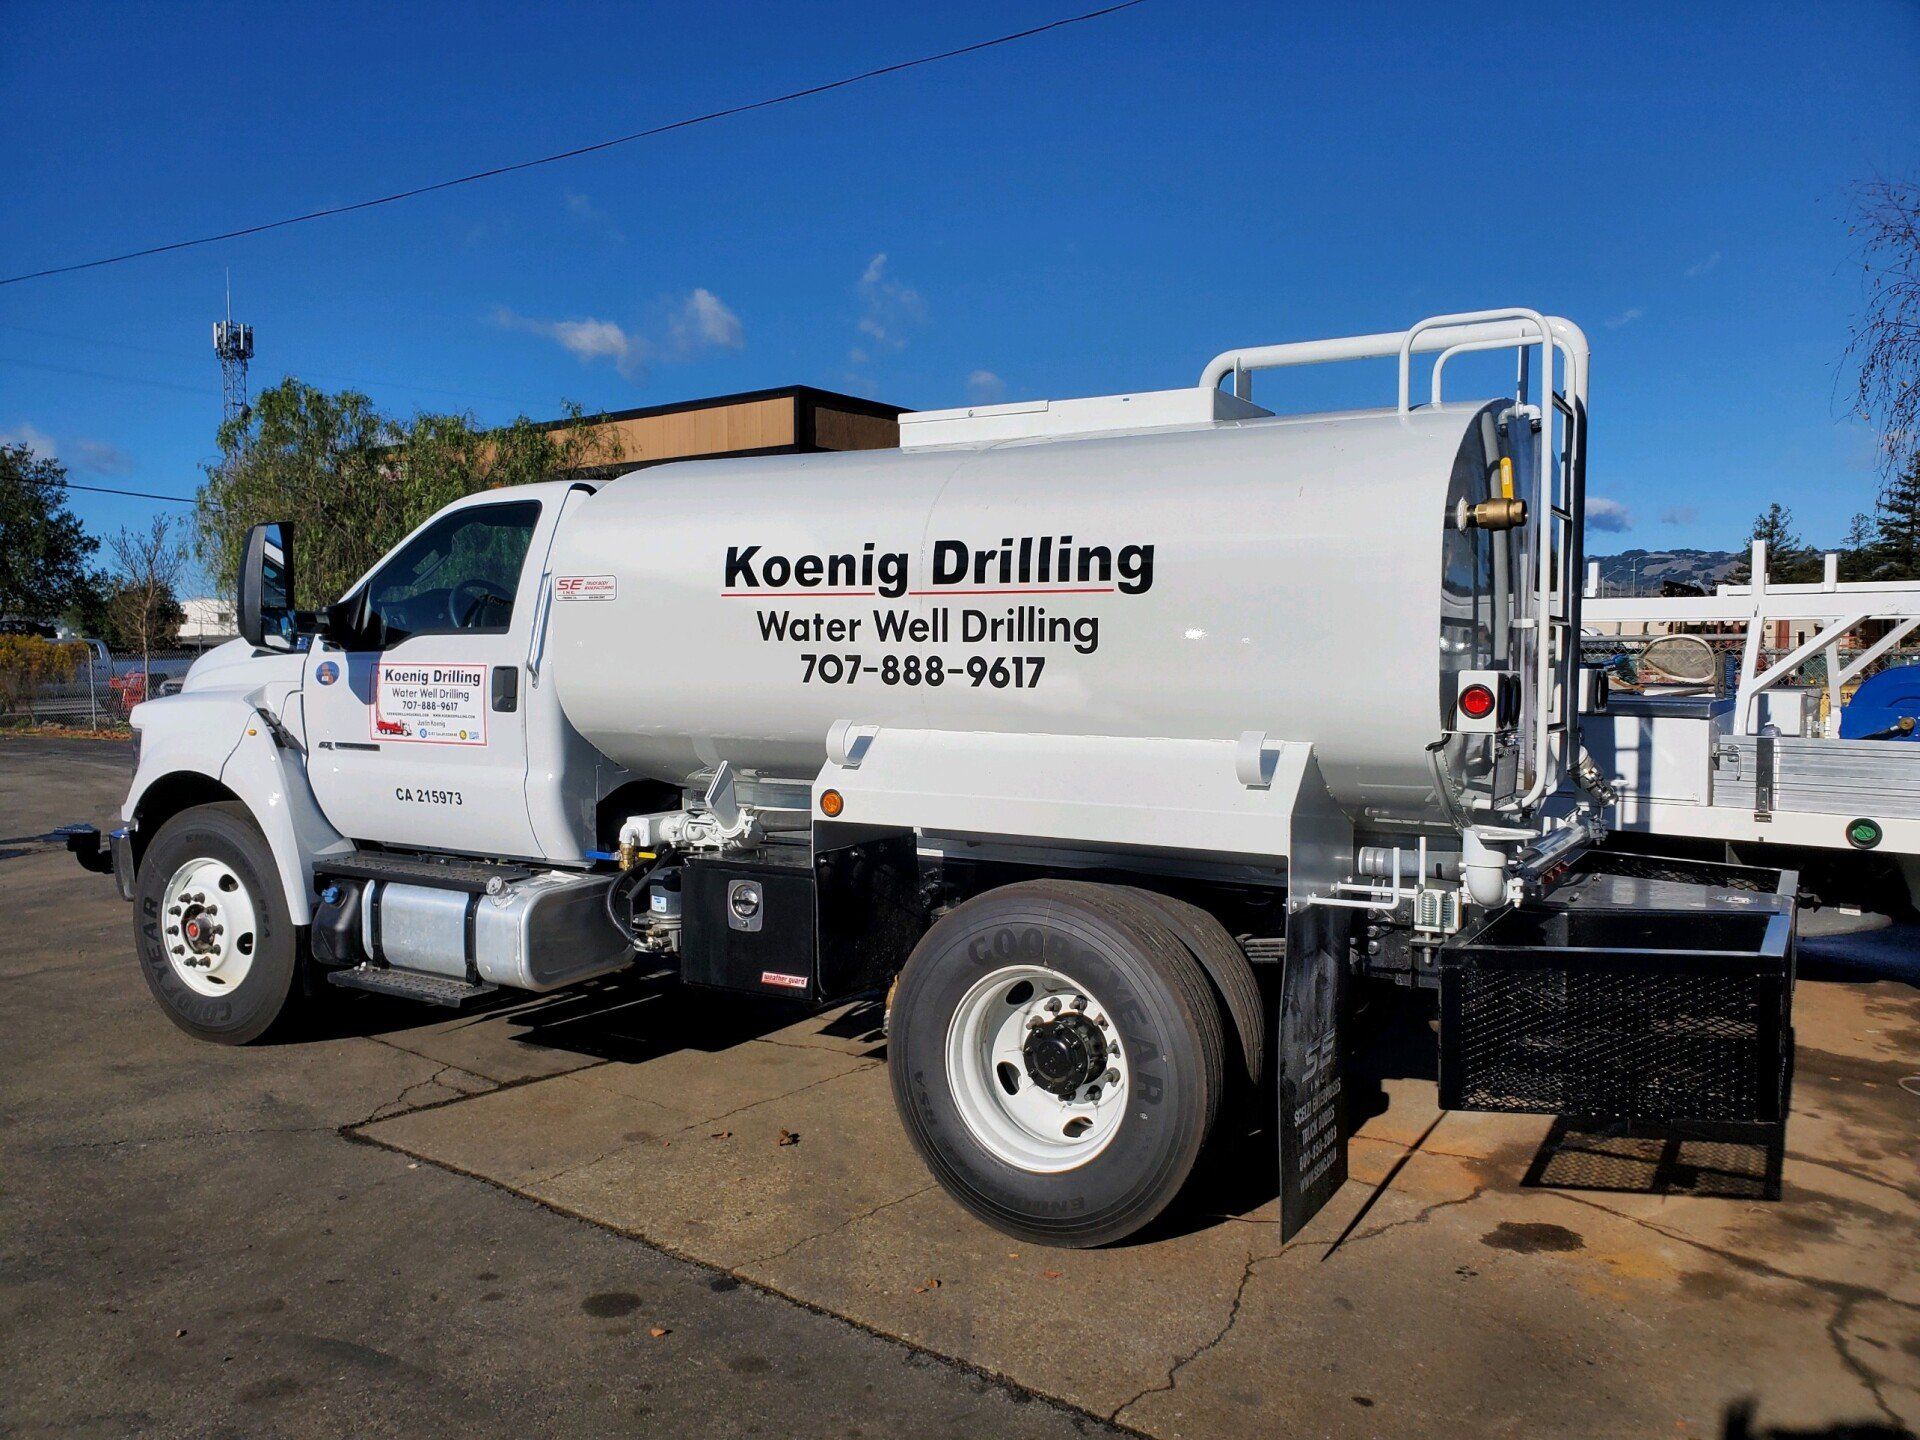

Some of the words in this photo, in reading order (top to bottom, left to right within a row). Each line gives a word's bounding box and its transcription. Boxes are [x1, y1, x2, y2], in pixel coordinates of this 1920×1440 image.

[724, 543, 909, 598] Koenig
[932, 535, 1155, 595] Drilling
[557, 579, 584, 590] SE
[756, 610, 861, 643] Water
[873, 606, 948, 643] Well
[962, 606, 1099, 654] Drilling
[385, 669, 429, 686] Koenig
[433, 670, 481, 687] Drilling
[800, 654, 1046, 688] 707-888-9617
[392, 688, 417, 698] Water
[419, 688, 438, 699] Well
[439, 689, 470, 702] Drilling
[402, 701, 459, 711] 707-888-9617
[395, 787, 414, 802] CA
[416, 789, 463, 806] 215973
